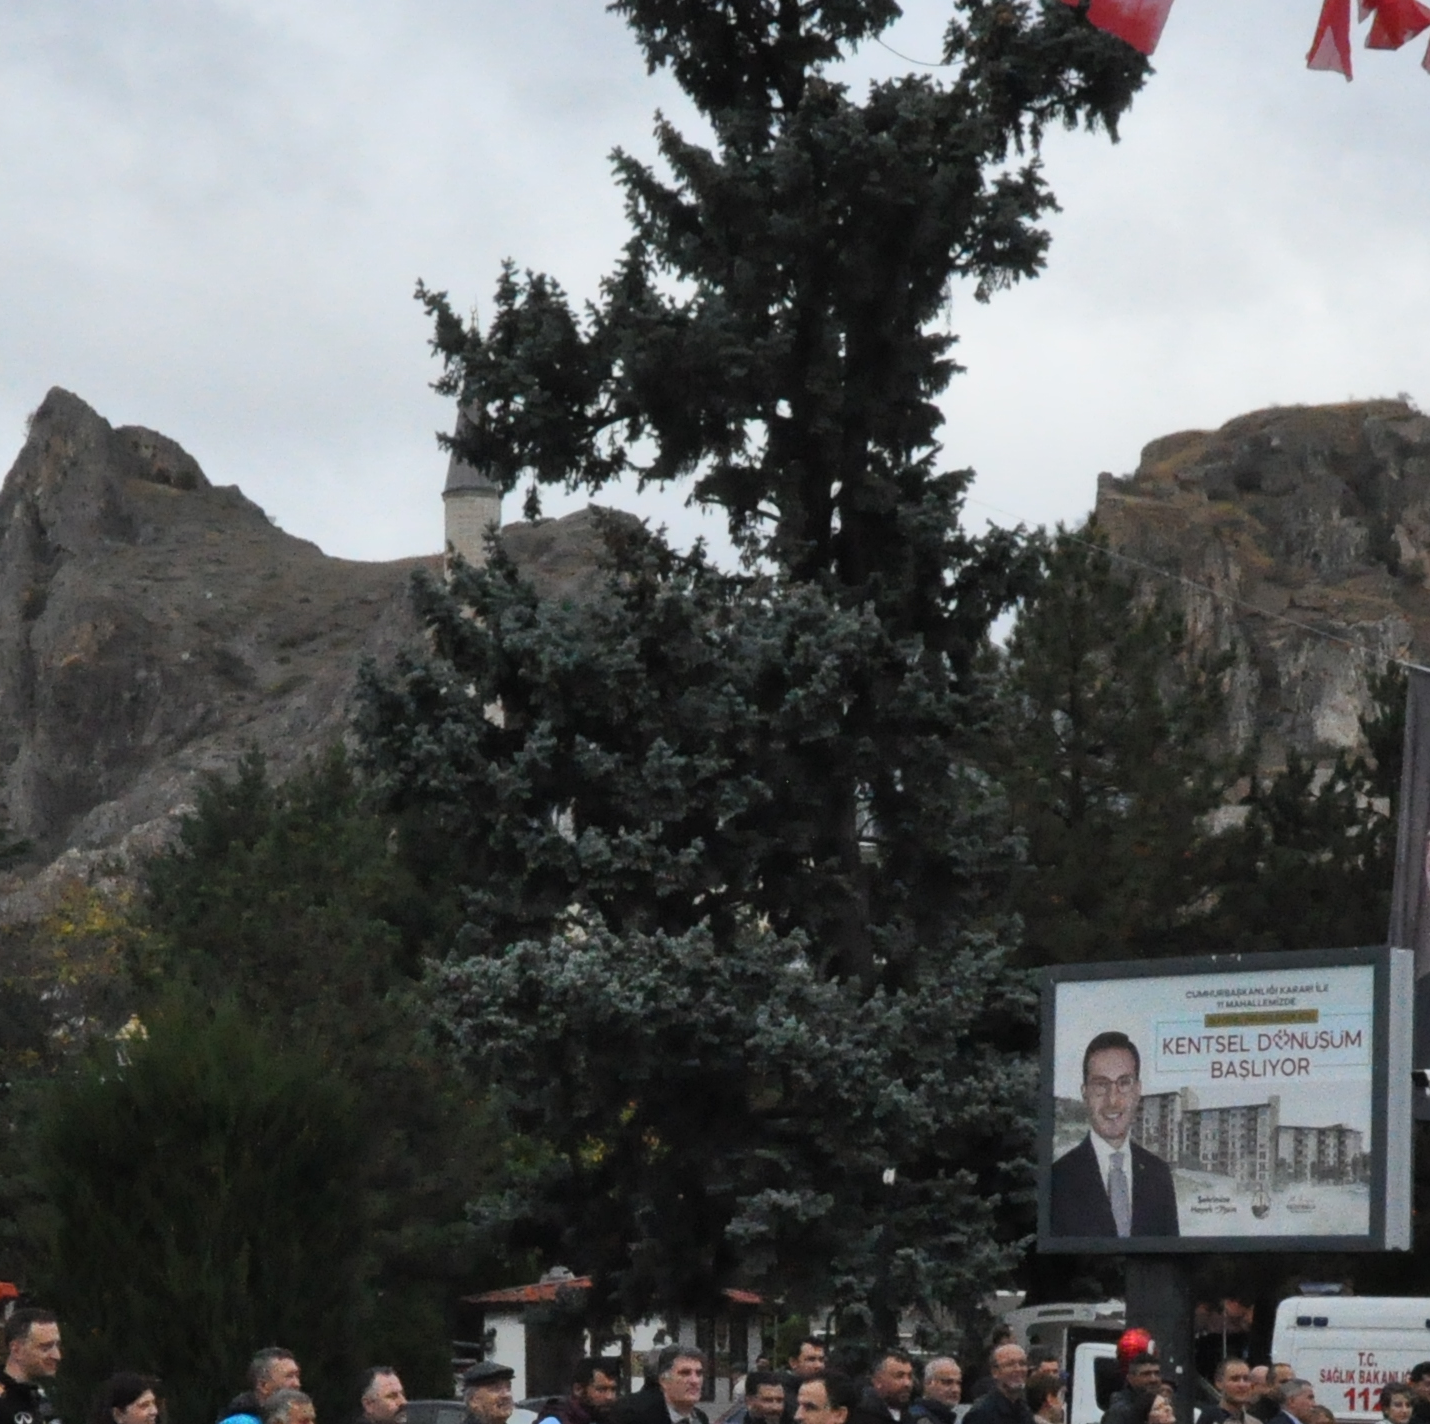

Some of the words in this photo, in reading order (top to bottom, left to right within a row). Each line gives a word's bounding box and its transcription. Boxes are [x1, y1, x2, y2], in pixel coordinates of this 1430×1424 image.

[1162, 1034, 1251, 1055] KENTSEL
[1257, 1029, 1362, 1052] DÖNÜŞÜM
[1211, 1057, 1311, 1080] BAŞLIYOR
[1358, 1352, 1378, 1367] T.C.
[1319, 1367, 1356, 1384] SAĞLIK
